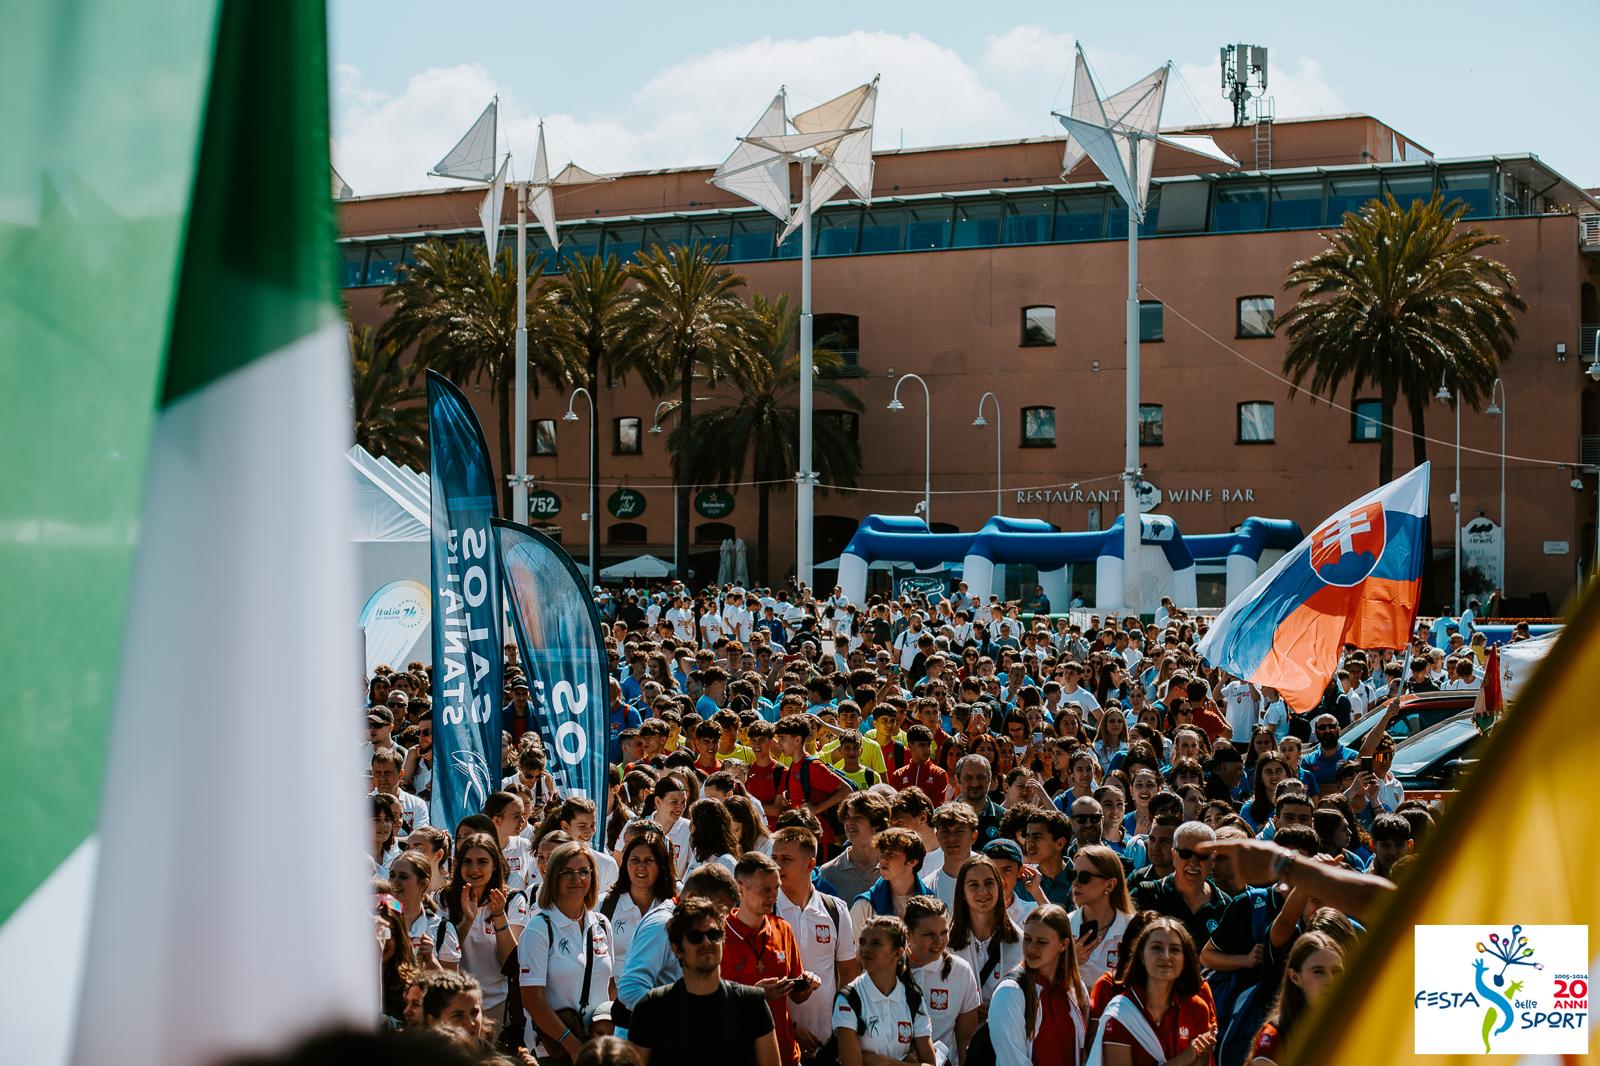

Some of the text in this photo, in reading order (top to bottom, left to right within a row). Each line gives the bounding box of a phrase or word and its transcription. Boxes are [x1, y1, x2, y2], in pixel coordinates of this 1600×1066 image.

[1017, 489, 1120, 503] RESTAURANT
[1168, 489, 1212, 503] WINE
[1222, 489, 1255, 503] BAR
